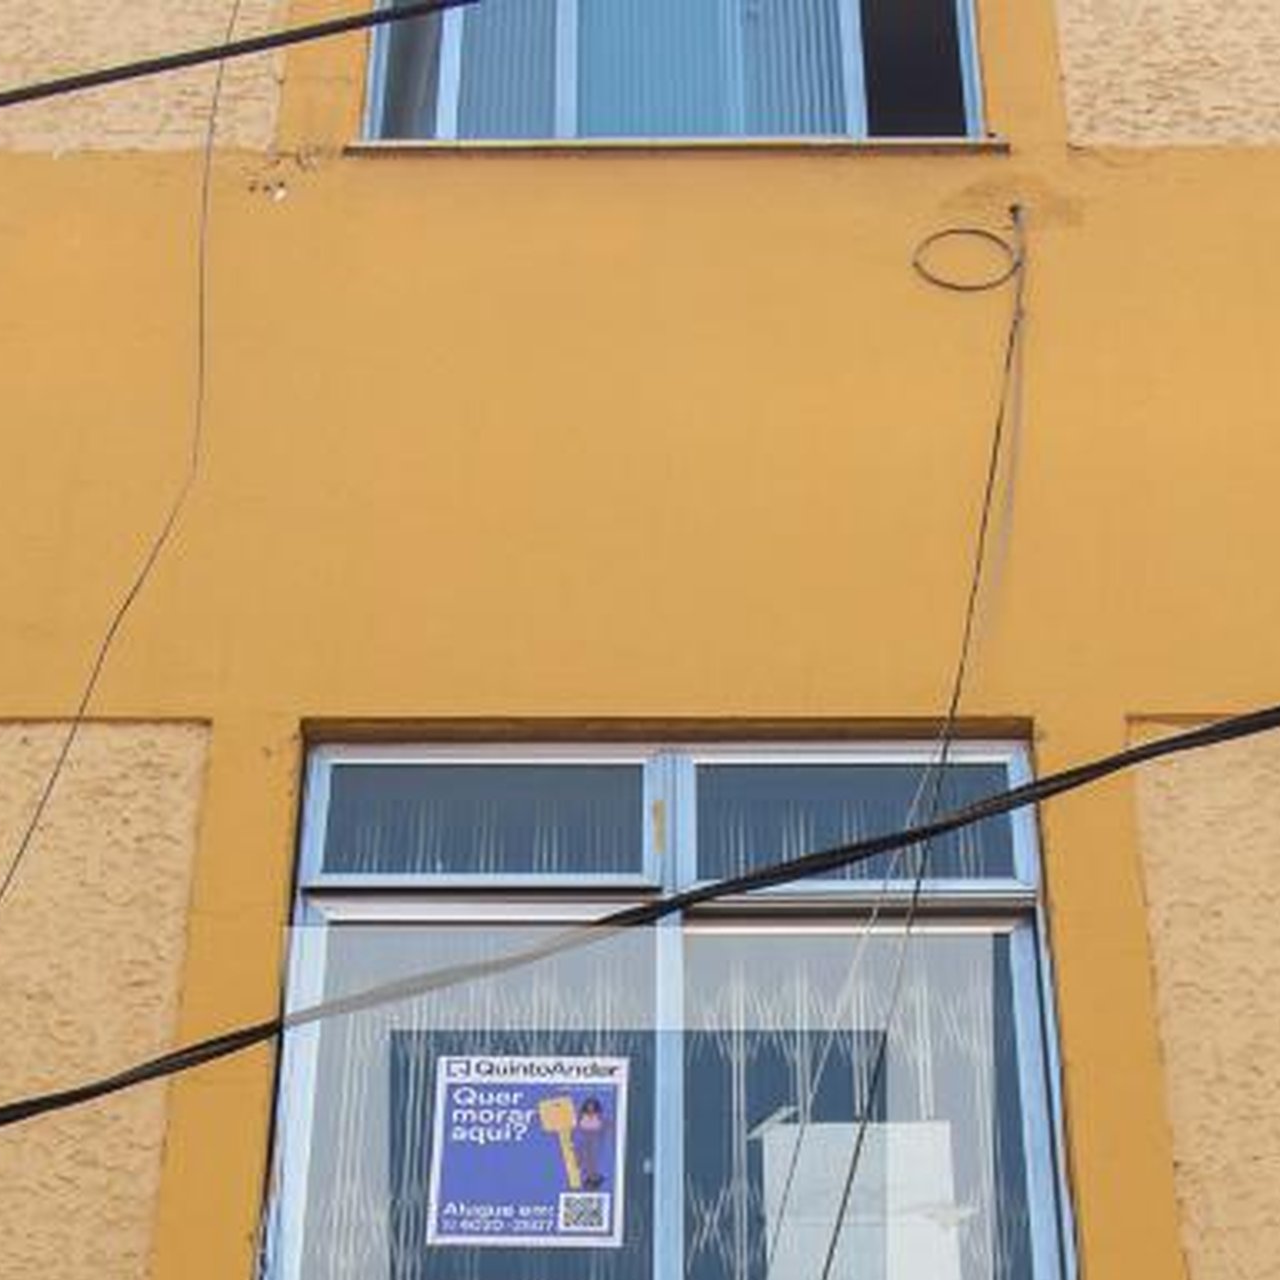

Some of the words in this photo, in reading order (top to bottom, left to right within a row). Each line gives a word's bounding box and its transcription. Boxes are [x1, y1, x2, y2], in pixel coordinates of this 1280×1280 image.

[474, 1060, 619, 1078] QuintoAndar
[452, 1086, 524, 1106] Quer
[451, 1107, 536, 1125] morar
[451, 1124, 529, 1145] aqui?
